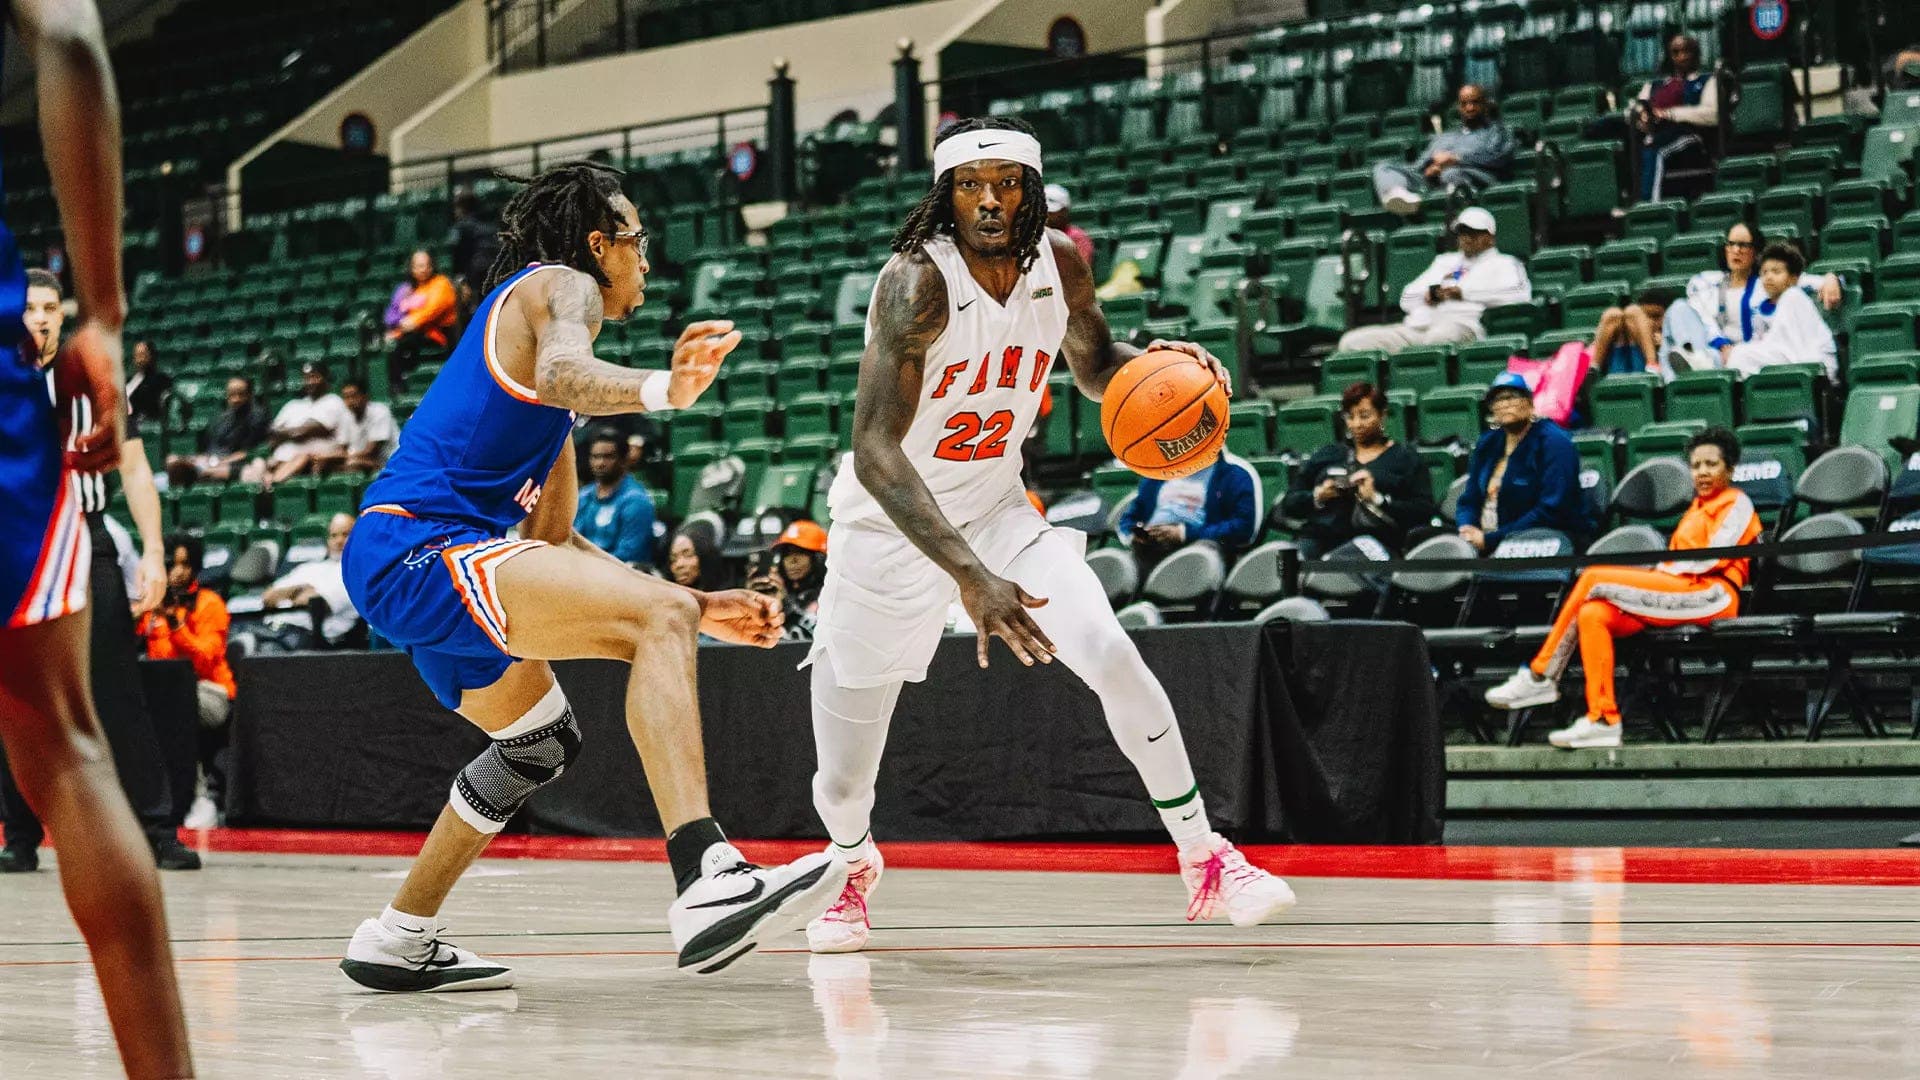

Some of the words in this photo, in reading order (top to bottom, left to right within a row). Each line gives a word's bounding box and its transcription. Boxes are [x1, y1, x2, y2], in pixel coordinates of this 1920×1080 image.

[931, 345, 1050, 399] FAMU
[933, 409, 1015, 462] 22
[1154, 401, 1219, 461] NAIA
[1731, 460, 1782, 482] SERVED
